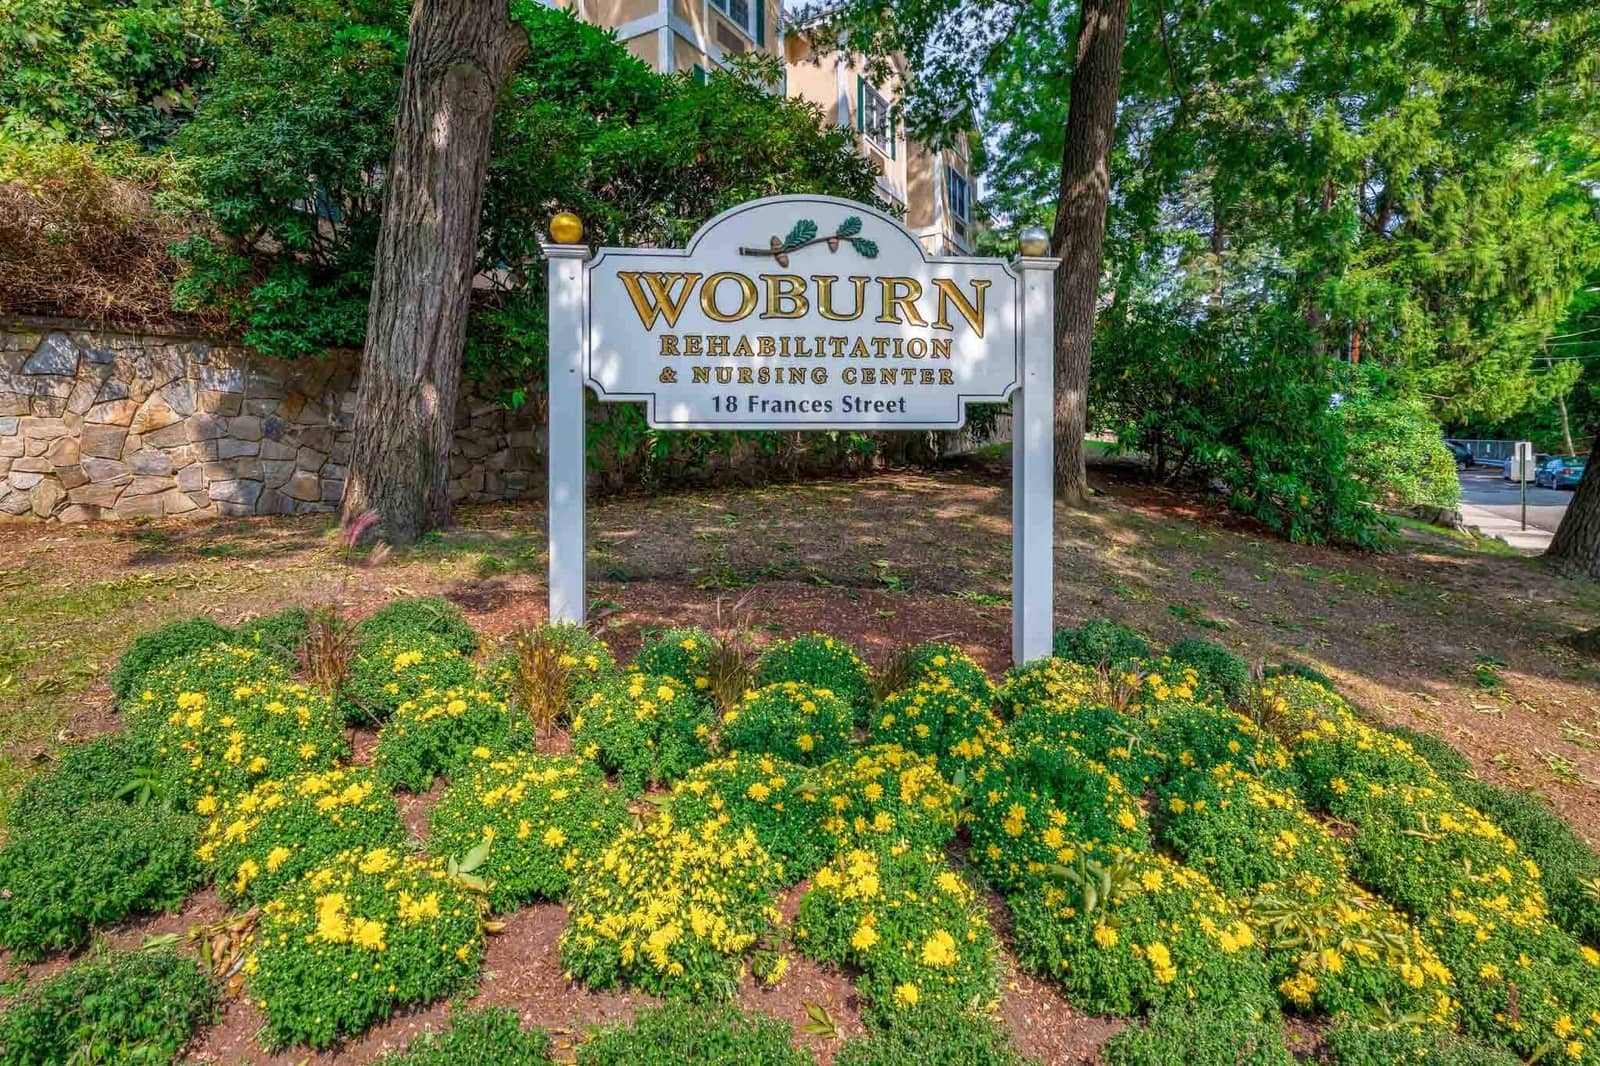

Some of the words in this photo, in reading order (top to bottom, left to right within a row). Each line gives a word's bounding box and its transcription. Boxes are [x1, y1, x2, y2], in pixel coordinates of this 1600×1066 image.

[618, 271, 992, 338] WOBURN
[660, 334, 952, 359] REHABILITATION
[659, 367, 678, 384] &
[693, 366, 828, 384] NURSING
[842, 367, 955, 385] CENTER
[712, 395, 738, 412] 18
[749, 395, 833, 413] Frances
[842, 395, 907, 413] Street
